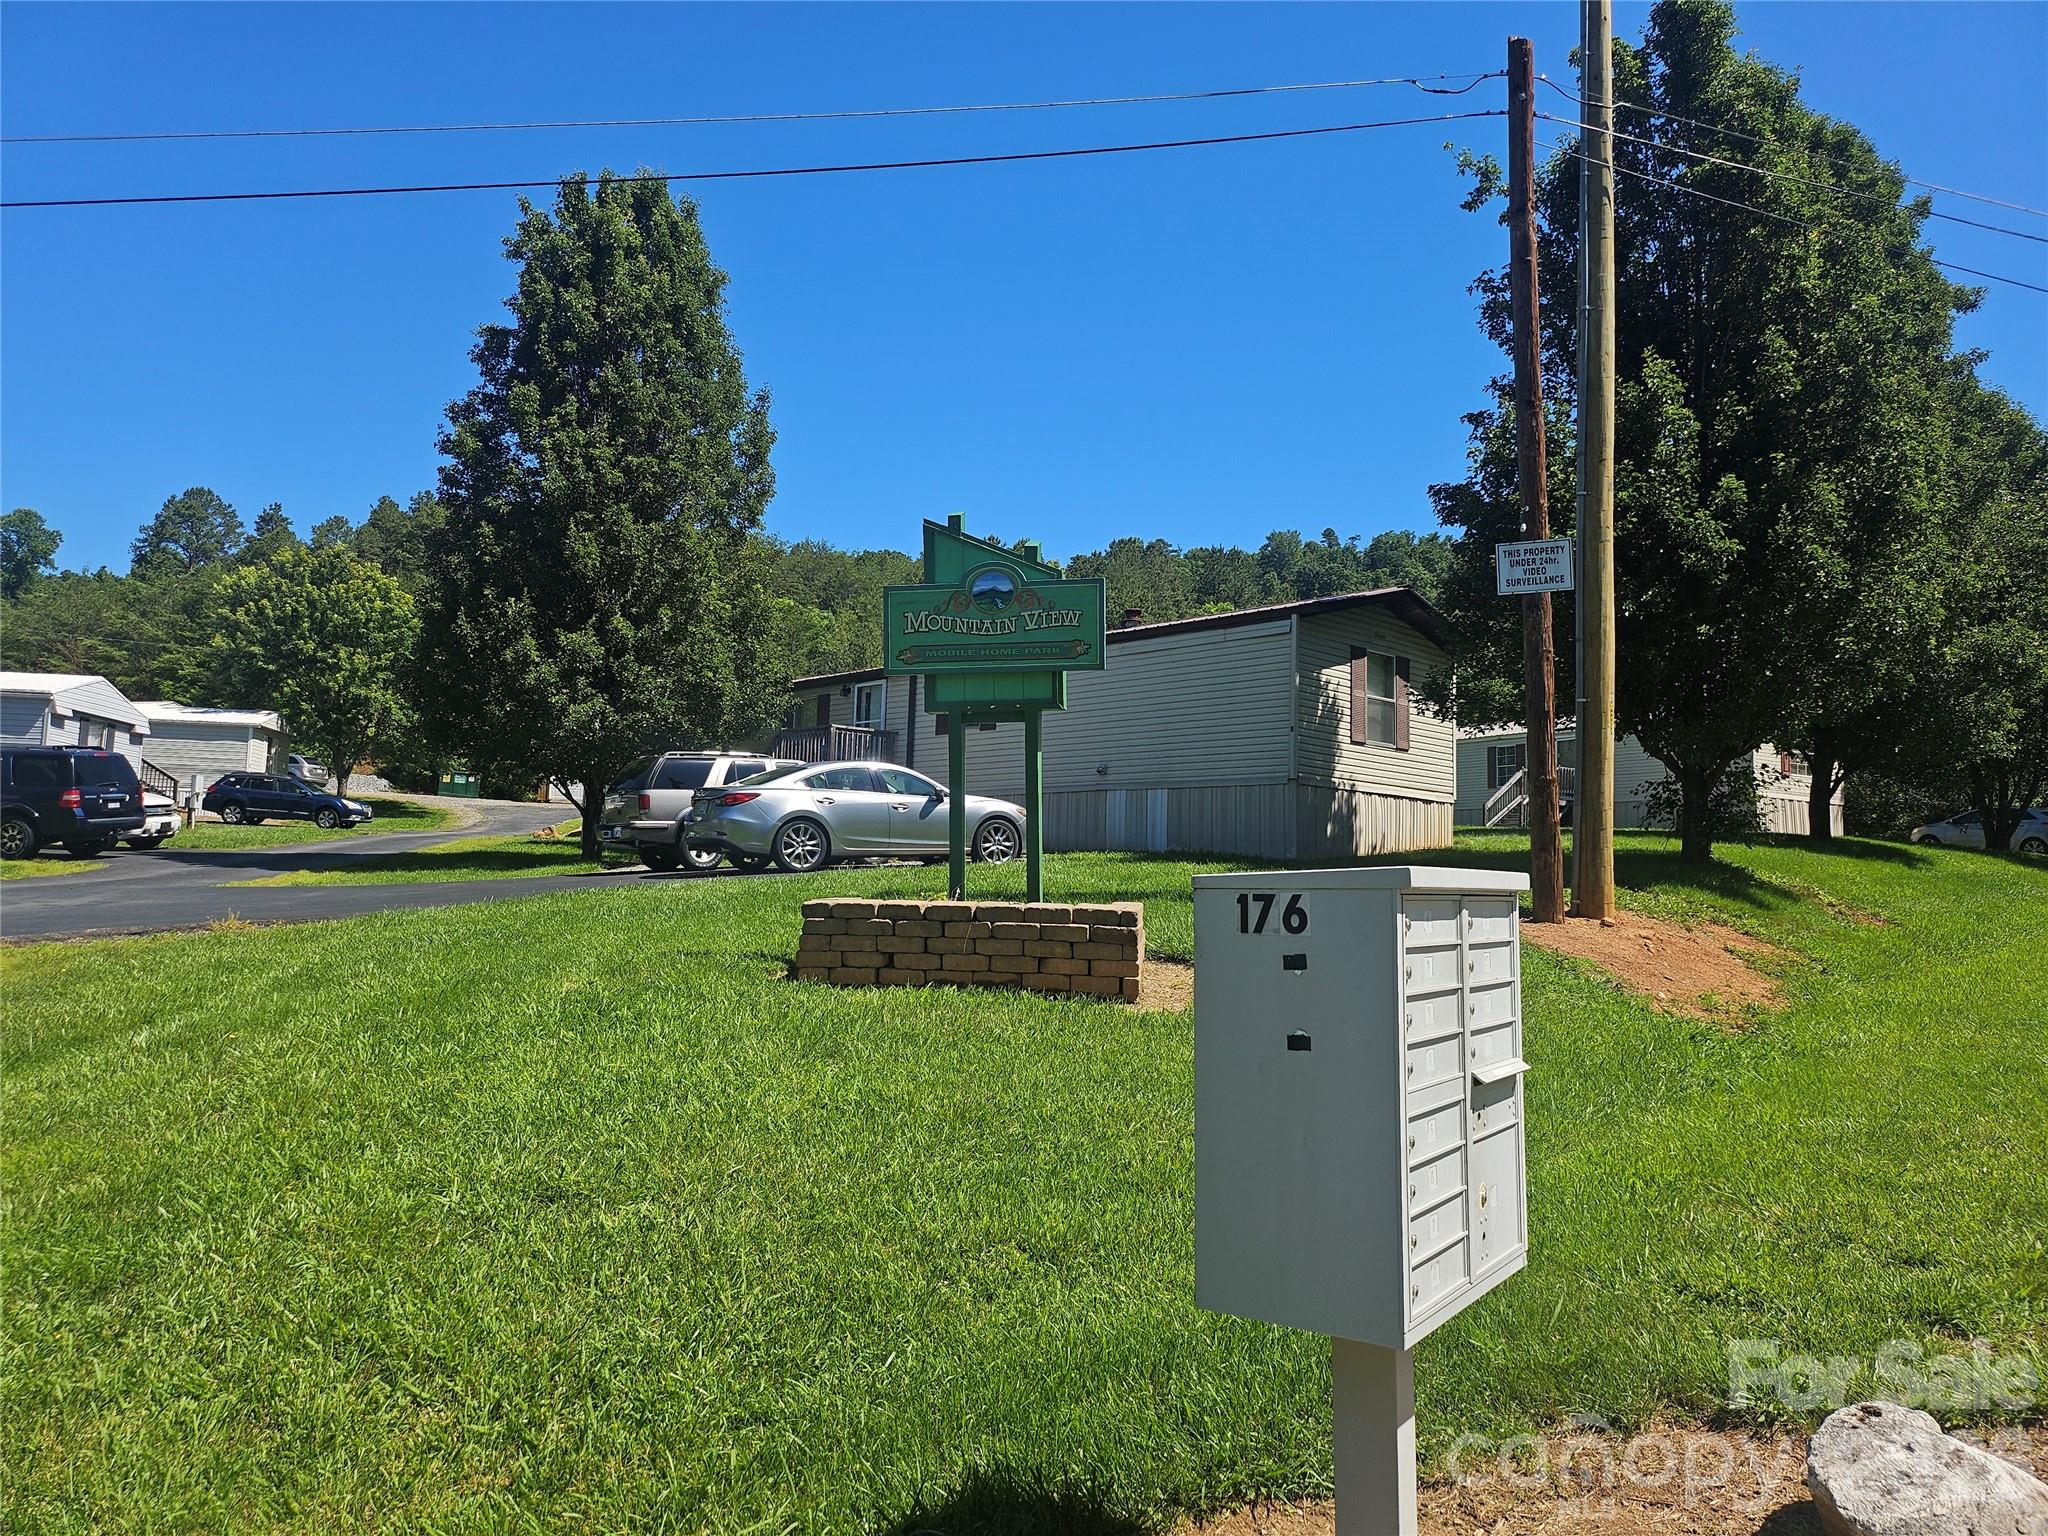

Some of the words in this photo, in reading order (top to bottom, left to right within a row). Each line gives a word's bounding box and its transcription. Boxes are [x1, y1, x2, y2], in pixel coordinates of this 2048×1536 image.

[1503, 549, 1521, 559] THIS
[1523, 545, 1565, 557] PROPERTY
[1509, 557, 1537, 568] UNDER
[1539, 556, 1560, 566] 24hr.
[1522, 566, 1547, 577] VIDEO
[1505, 574, 1565, 588] SURVEILLANCE
[903, 611, 1018, 636] MOUNTAIN
[1021, 609, 1083, 631] VIEW
[925, 649, 976, 657] MOBILE
[980, 648, 1021, 656] HOME
[1024, 647, 1061, 655] PARK
[1235, 893, 1309, 935] 176
